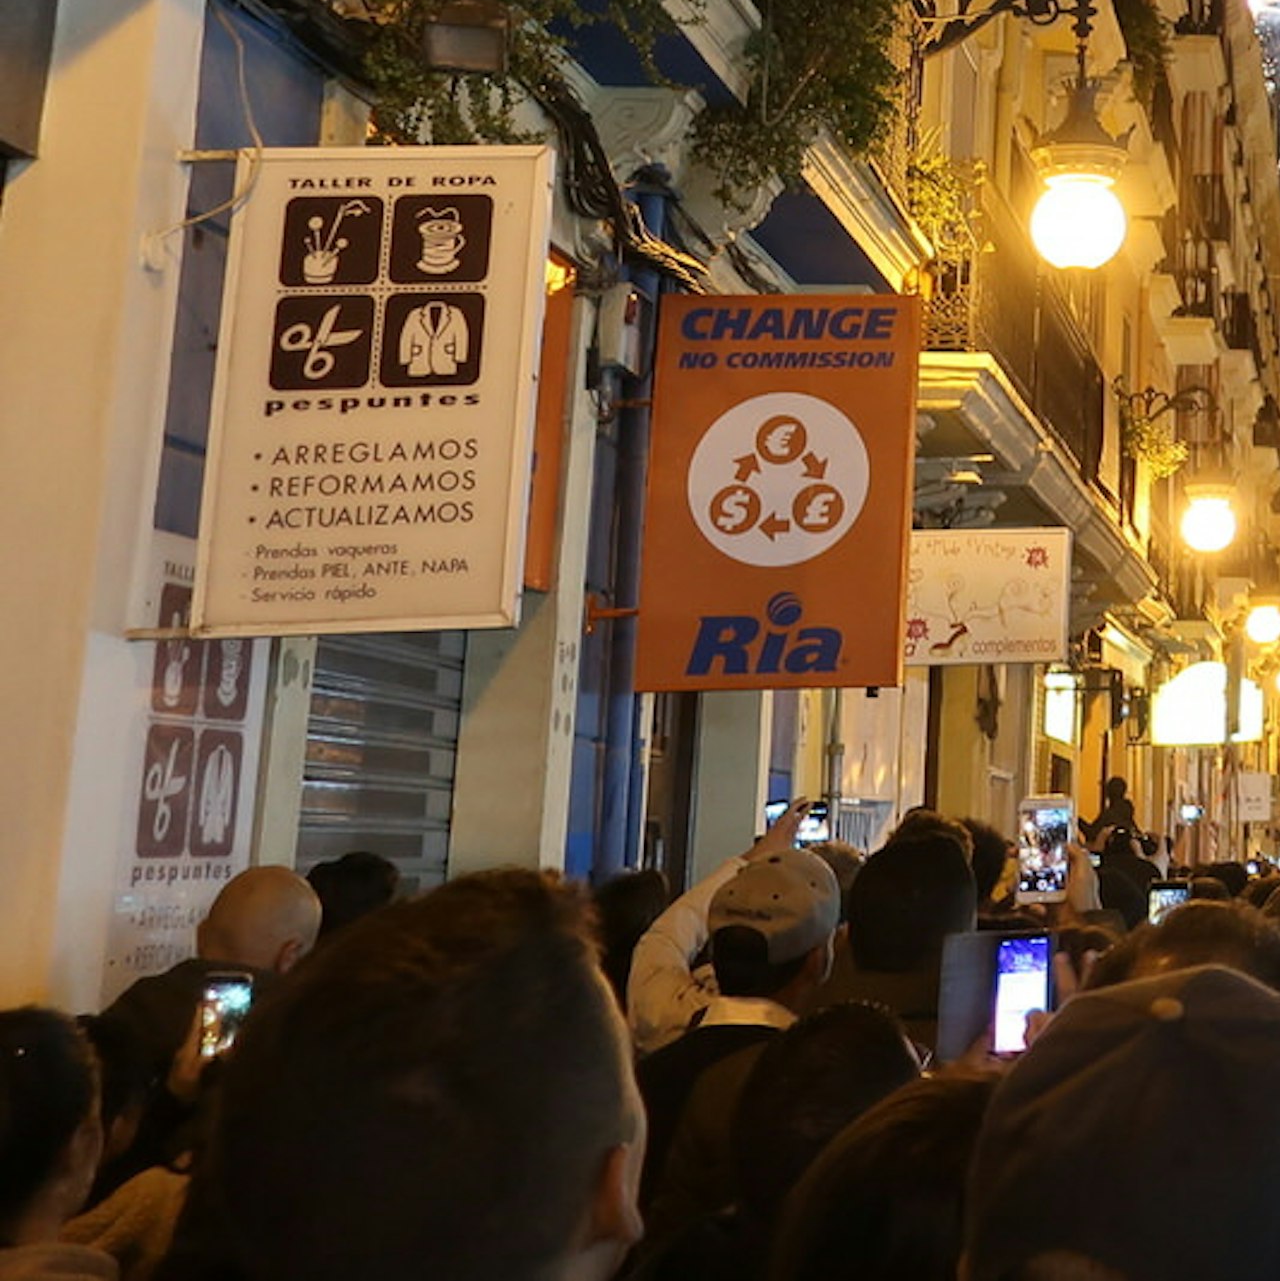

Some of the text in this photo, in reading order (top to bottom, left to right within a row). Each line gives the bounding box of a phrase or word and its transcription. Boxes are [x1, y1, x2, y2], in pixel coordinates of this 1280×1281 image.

[288, 175, 497, 190] TALLER DE ROPA
[681, 307, 897, 341] CHANGE
[678, 350, 895, 369] NO COMMISSION
[264, 392, 480, 417] pespuntes
[271, 438, 478, 466] ARREGLAMOS
[269, 469, 476, 498] REFORMAMOS
[265, 500, 474, 530] ACTUALIZAMOS
[255, 543, 398, 560] Prendas vaqueros
[253, 564, 316, 581] Prendas
[421, 558, 470, 574] NAPA
[251, 582, 377, 603] Servicio rápido
[685, 591, 843, 677] Ria
[971, 637, 1057, 657] complementos
[131, 862, 233, 887] pespuntes
